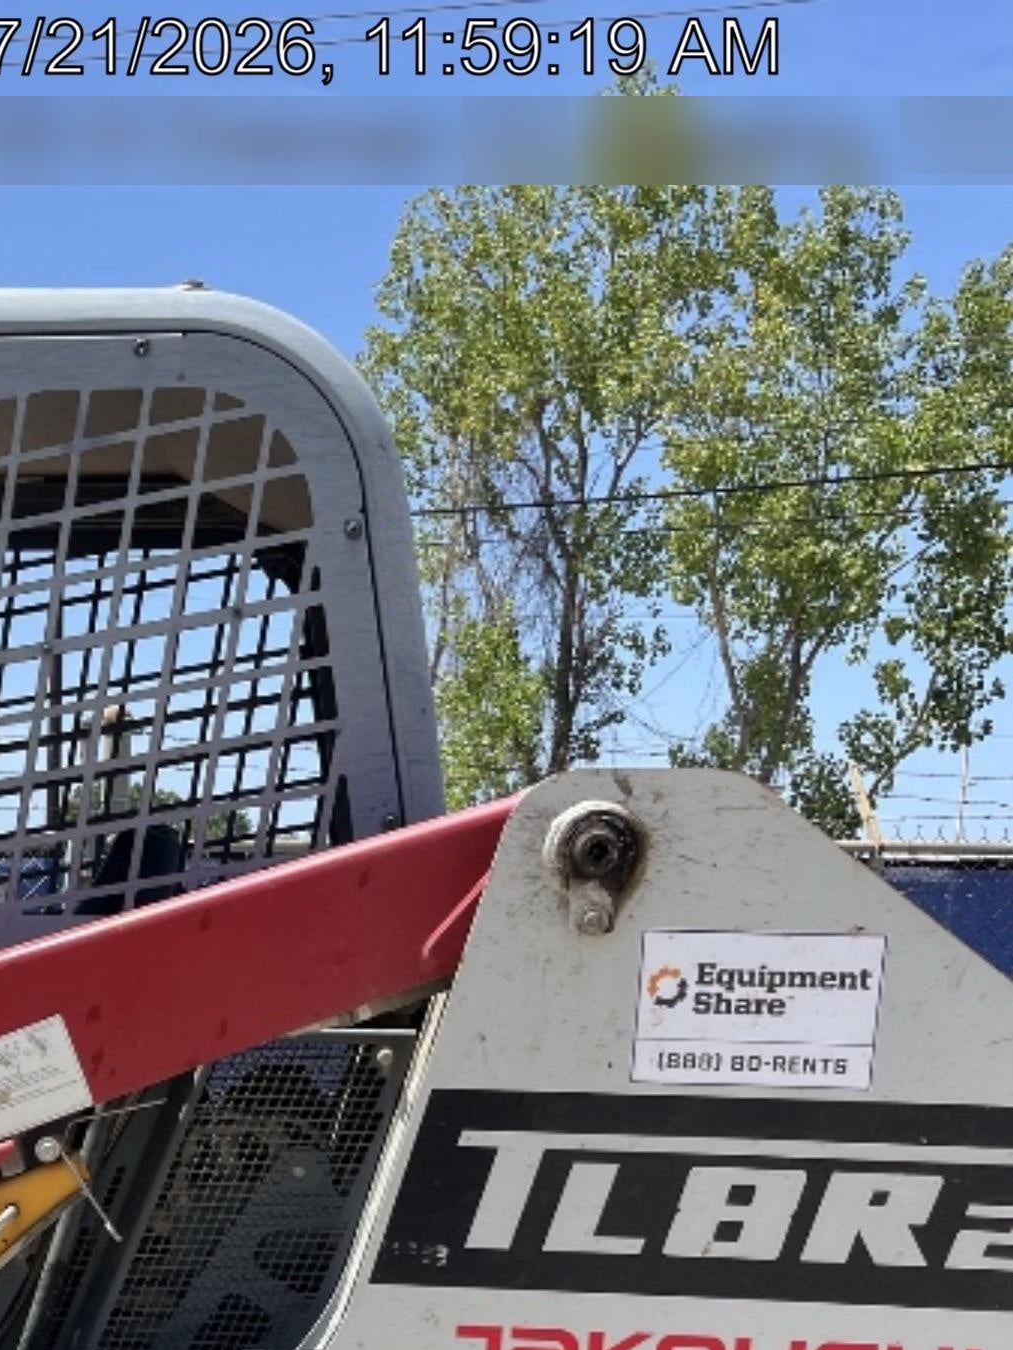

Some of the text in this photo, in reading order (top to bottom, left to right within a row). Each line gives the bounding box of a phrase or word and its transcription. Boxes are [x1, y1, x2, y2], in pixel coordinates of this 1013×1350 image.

[694, 962, 873, 994] Equipment
[692, 991, 787, 1017] Share
[730, 1055, 848, 1075] 80-RENTS
